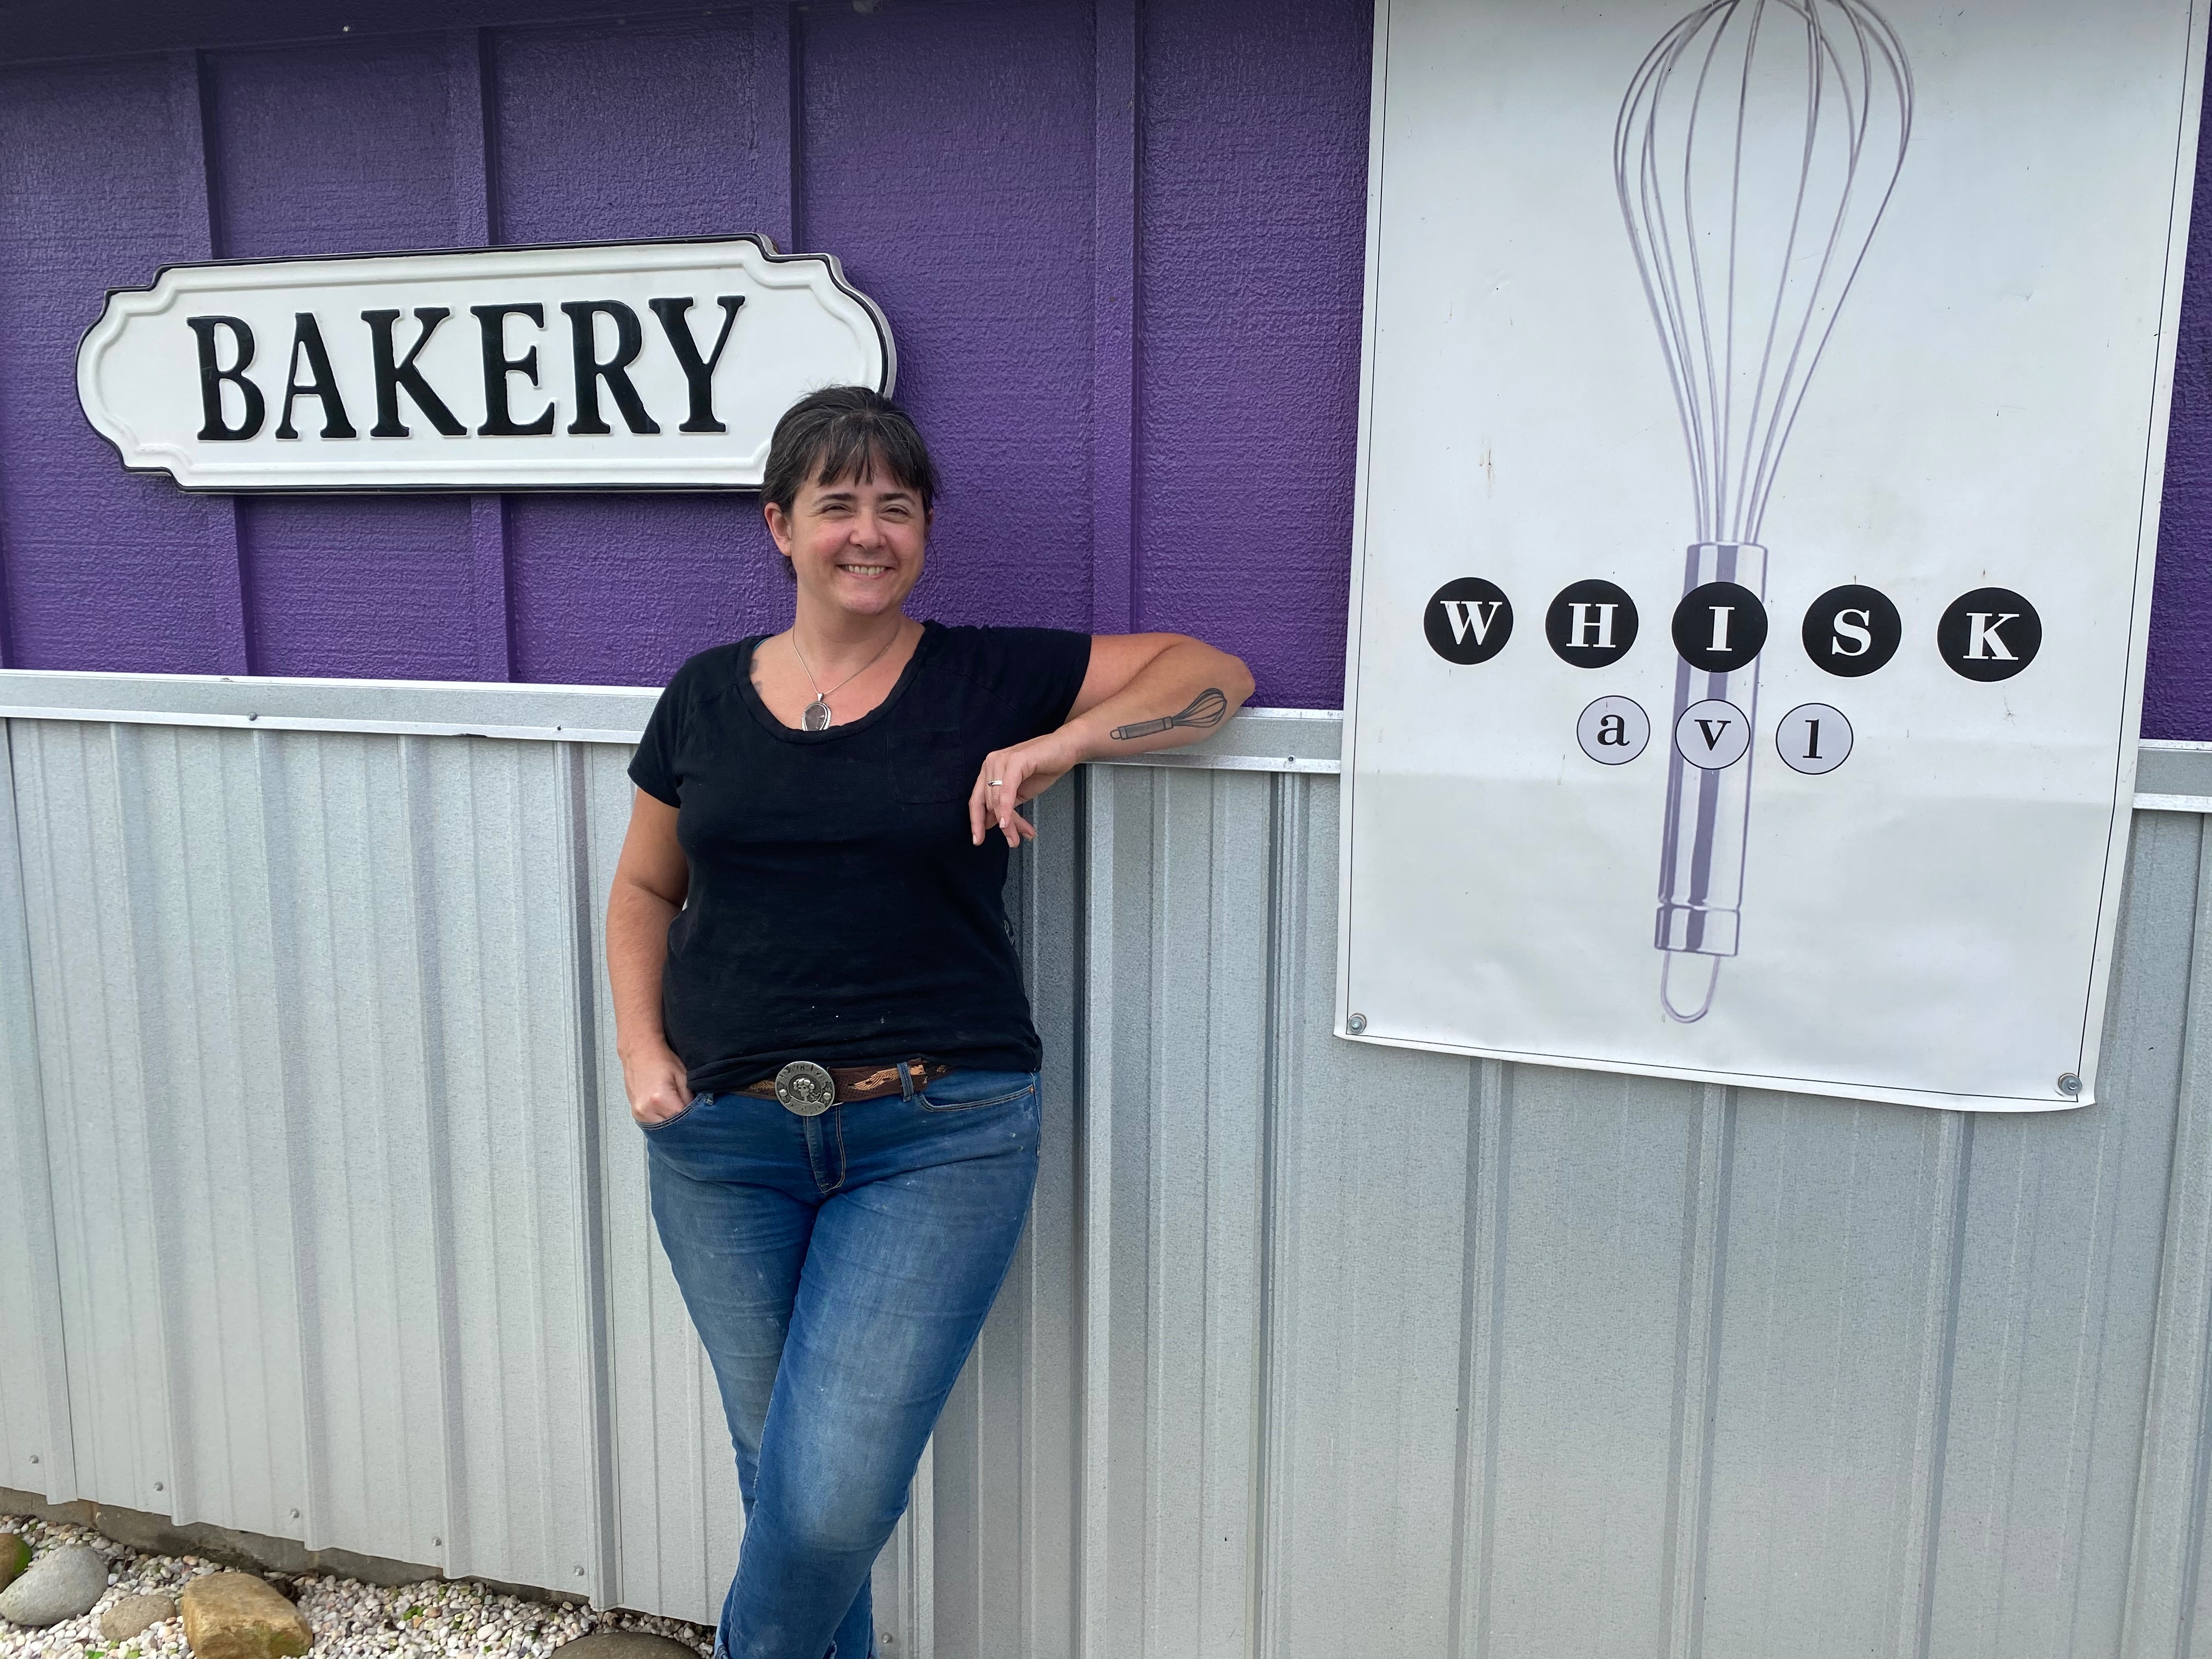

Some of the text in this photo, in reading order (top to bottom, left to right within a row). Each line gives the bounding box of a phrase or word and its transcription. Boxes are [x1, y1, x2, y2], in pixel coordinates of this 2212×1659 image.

[187, 295, 746, 441] BAKERY
[1439, 600, 2020, 661] WHISK
[1596, 714, 1823, 760] avl
